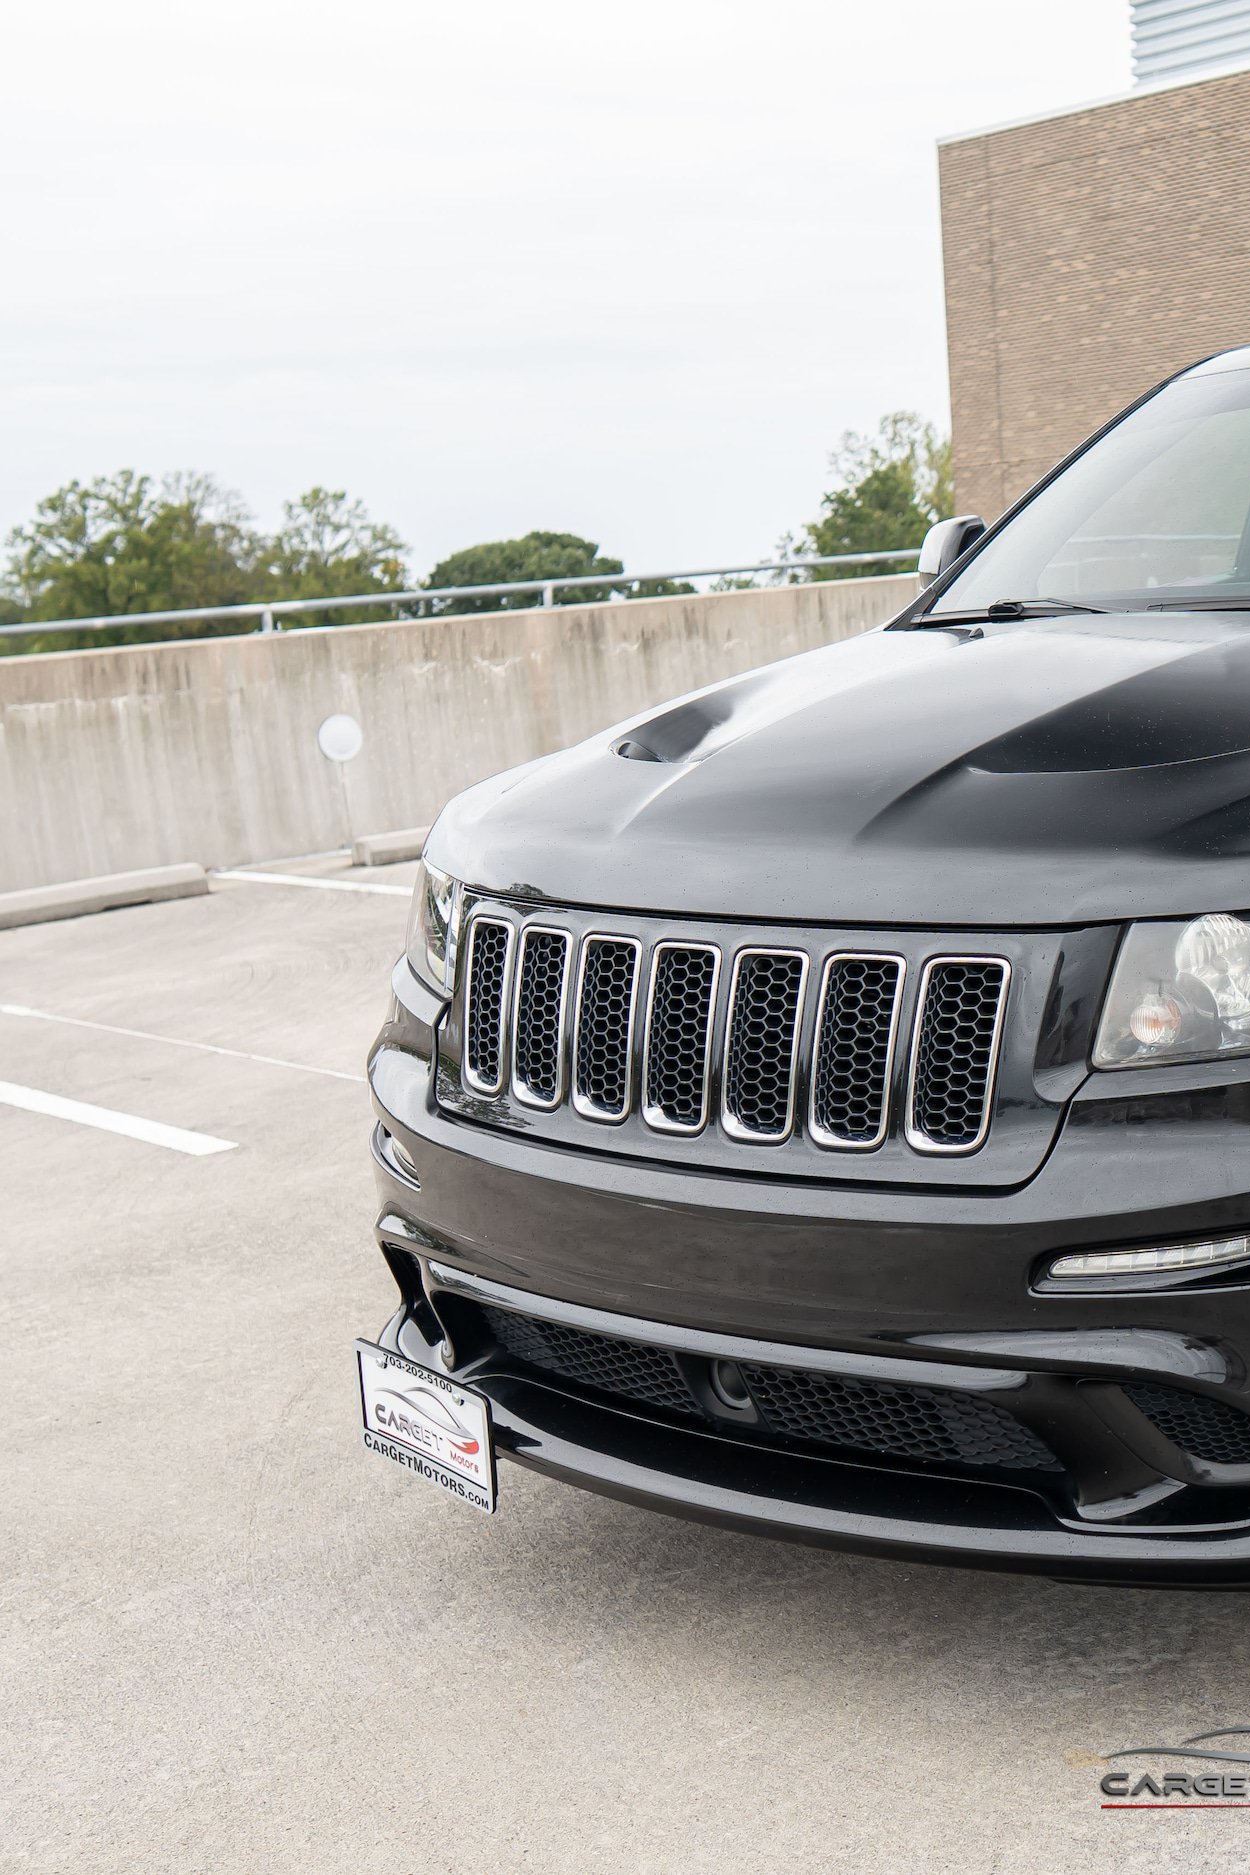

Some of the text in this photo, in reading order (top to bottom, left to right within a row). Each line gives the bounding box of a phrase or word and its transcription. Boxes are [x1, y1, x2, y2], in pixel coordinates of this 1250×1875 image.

[383, 1353, 453, 1393] 703-202-5100
[375, 1403, 479, 1474] CARGET Motors
